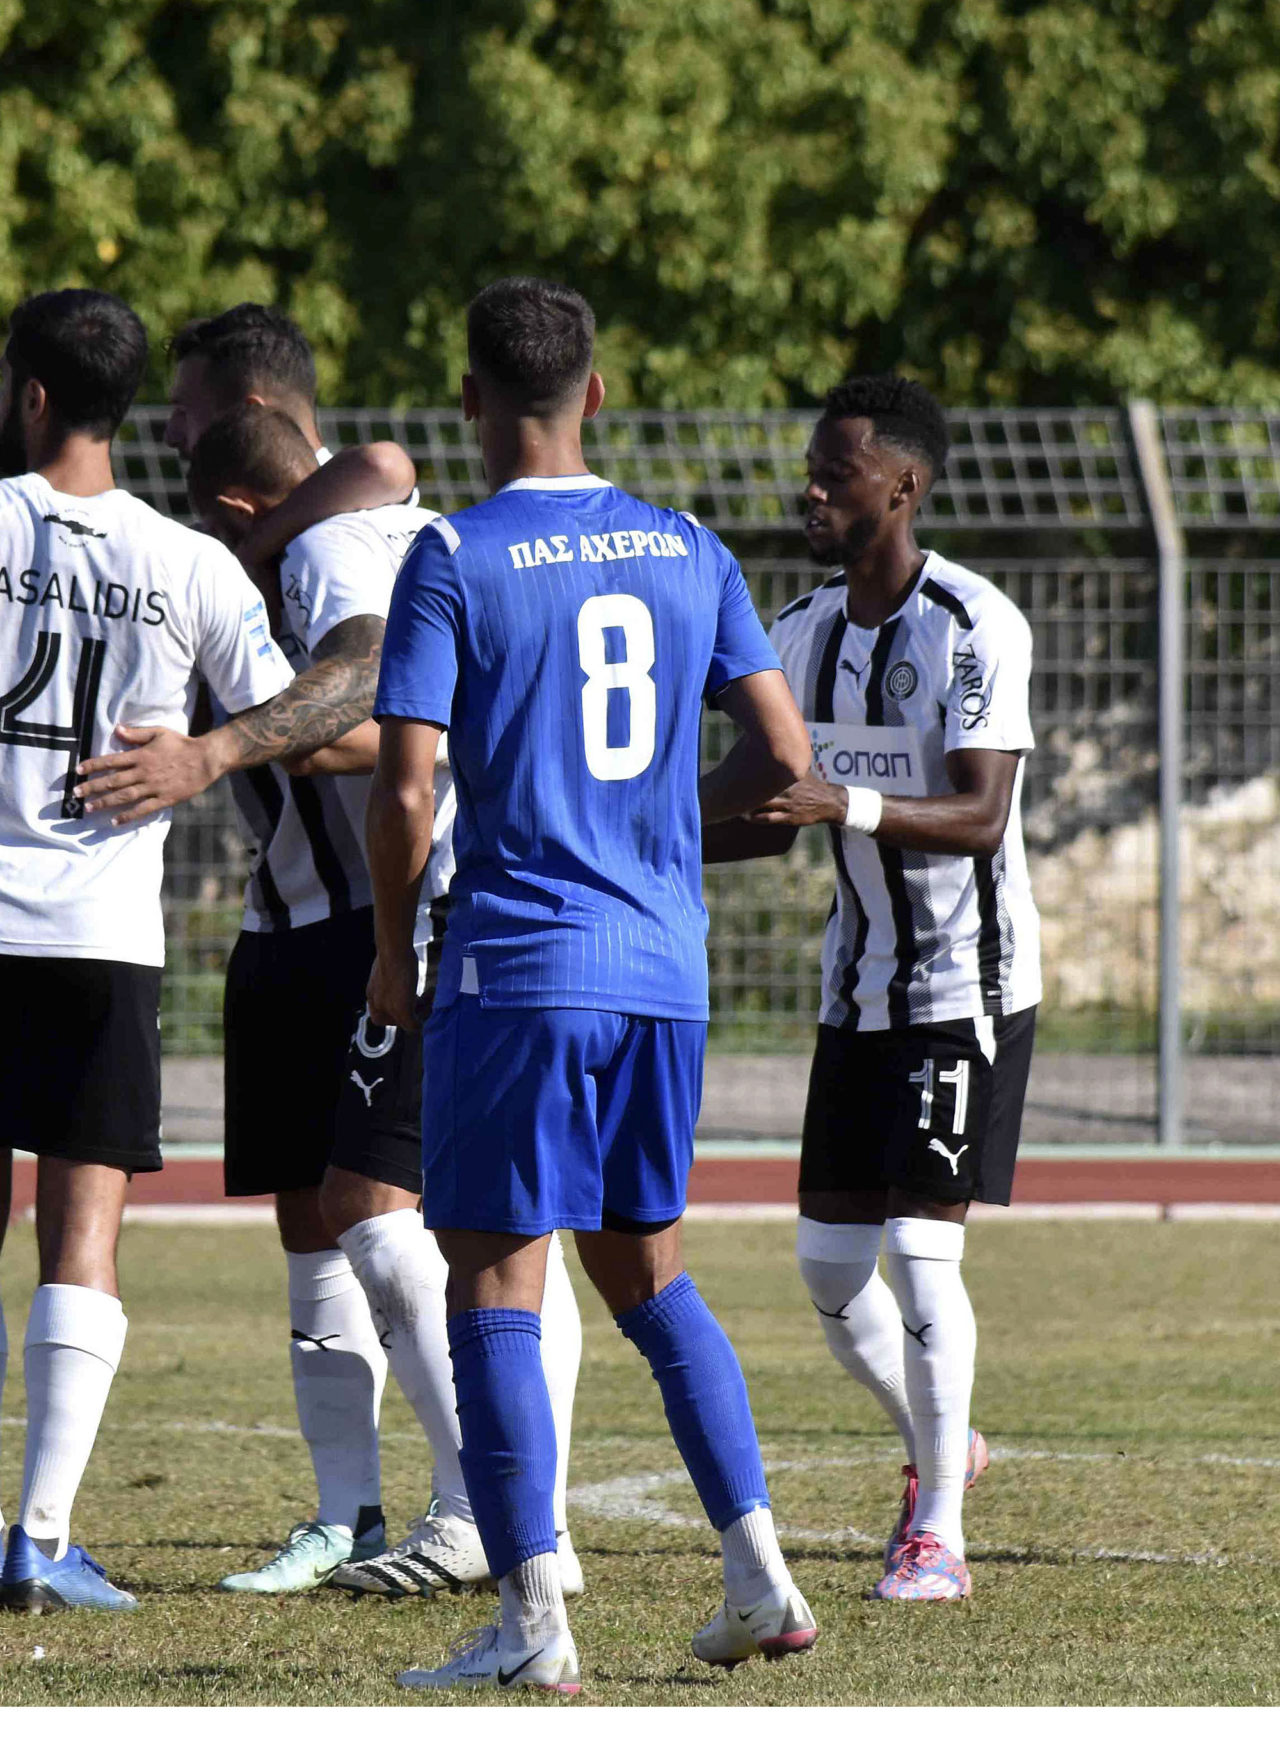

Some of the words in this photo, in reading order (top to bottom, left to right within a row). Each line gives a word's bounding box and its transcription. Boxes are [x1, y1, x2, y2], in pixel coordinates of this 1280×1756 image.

[508, 535, 574, 569] ΠΑΣ
[580, 530, 688, 563] ΑΧΕΡΩΝ
[577, 593, 657, 781] 8
[908, 1058, 970, 1135] 11
